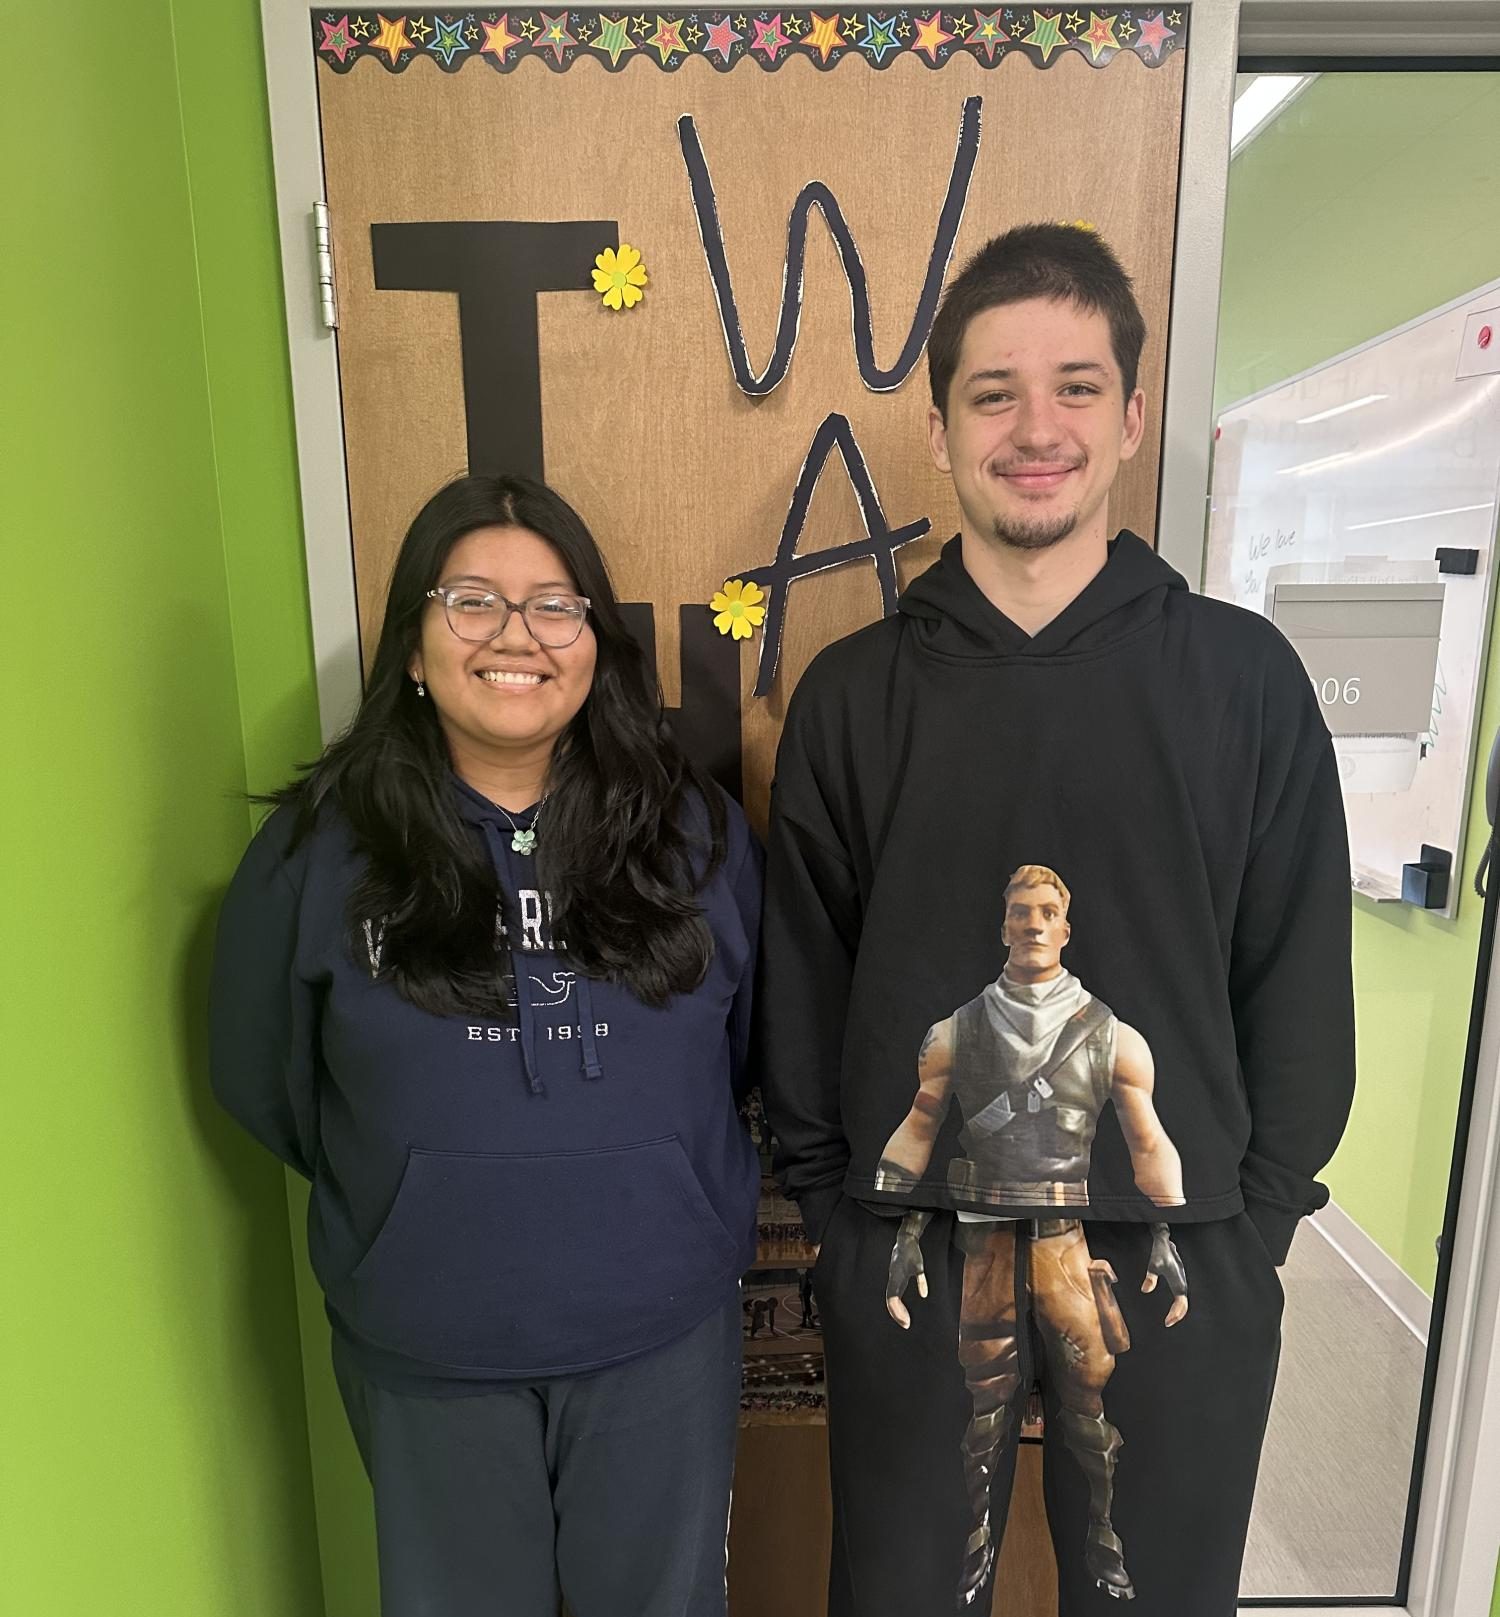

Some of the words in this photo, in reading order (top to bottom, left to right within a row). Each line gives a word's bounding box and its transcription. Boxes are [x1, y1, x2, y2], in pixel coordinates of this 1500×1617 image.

[371, 220, 619, 481] T
[677, 96, 983, 396] W
[726, 412, 932, 698] A
[1248, 533, 1271, 561] We
[1275, 529, 1296, 551] love
[1310, 677, 1361, 705] 06
